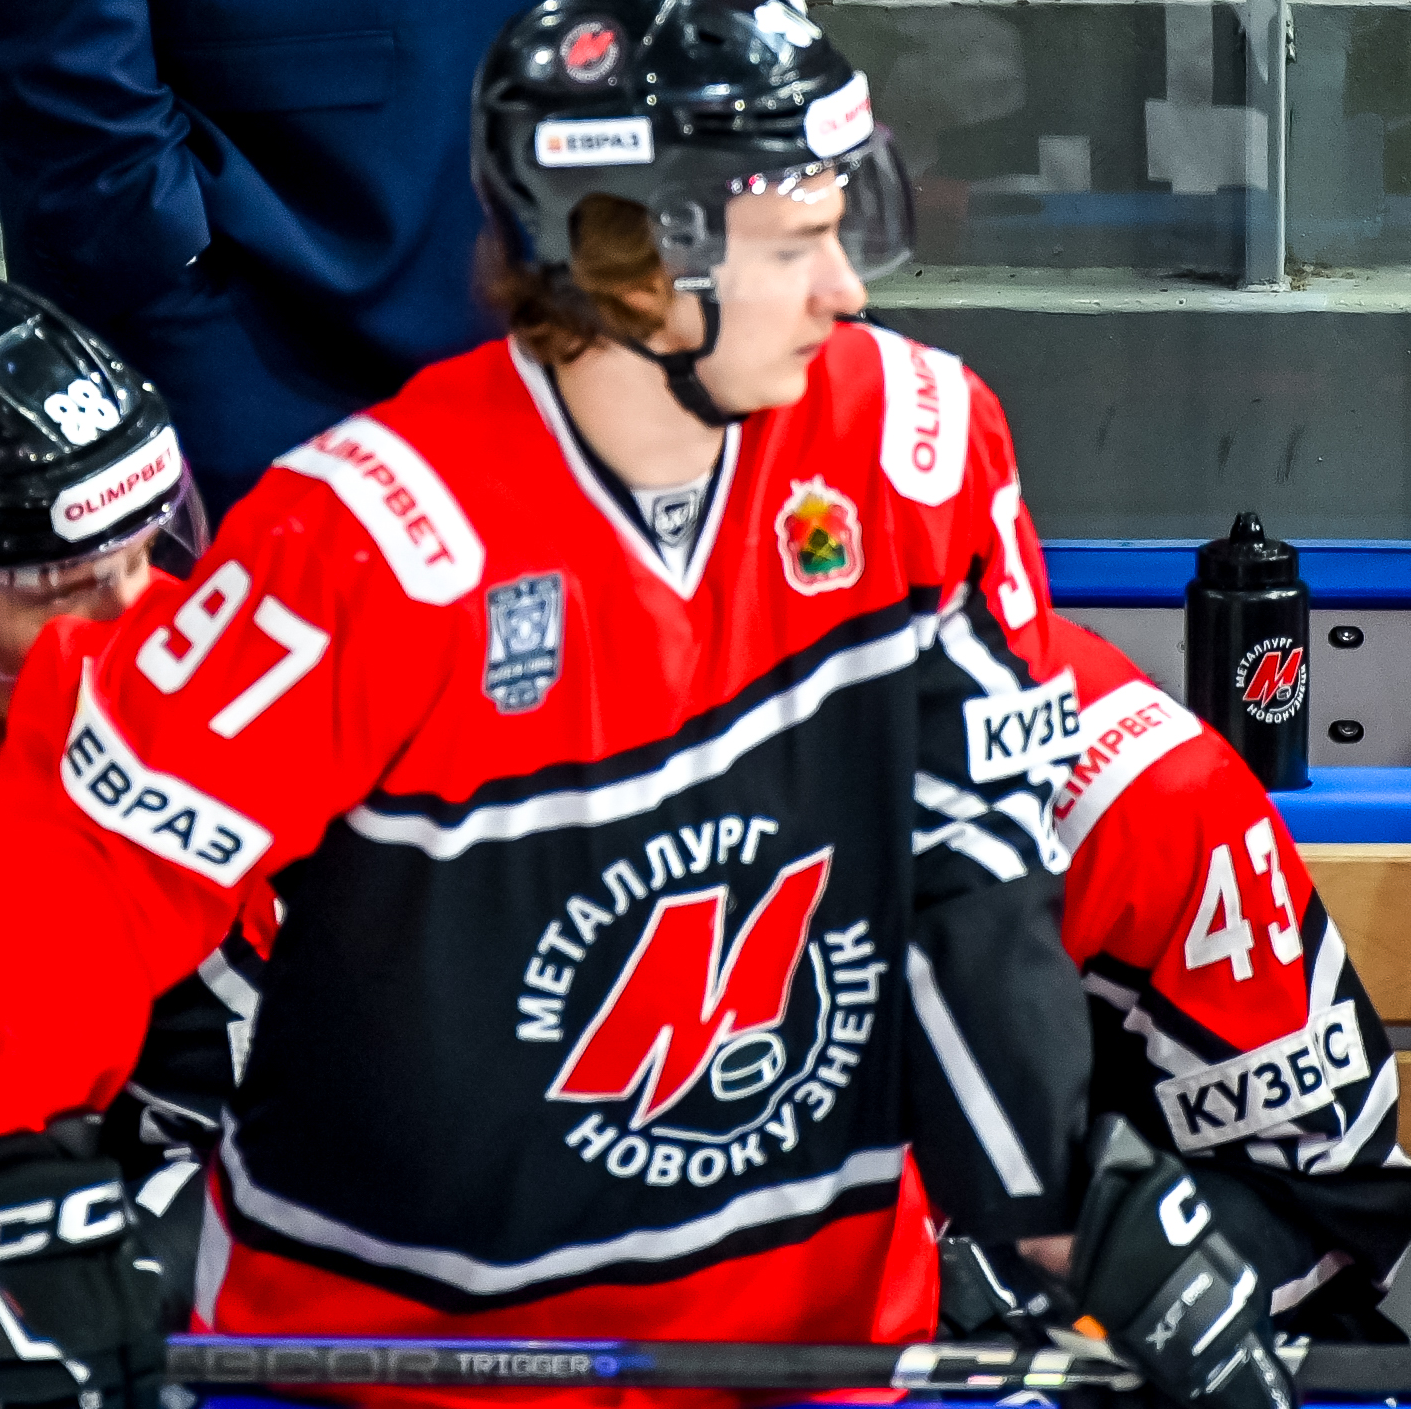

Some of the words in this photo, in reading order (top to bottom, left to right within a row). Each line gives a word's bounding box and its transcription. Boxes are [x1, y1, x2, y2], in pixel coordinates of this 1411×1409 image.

[43, 377, 120, 447] 88
[63, 447, 173, 523] OLIMPBET
[135, 559, 332, 740] 97
[1235, 637, 1293, 688] МЕТАЛЛУРГ
[66, 726, 243, 866] ЕВРАЗ
[516, 813, 779, 1042] МЕТАЛЛУРГ
[1184, 817, 1304, 982] 43
[565, 919, 889, 1188] НОВОКУЗНЕЦК
[457, 1353, 591, 1379] TRIGGER
